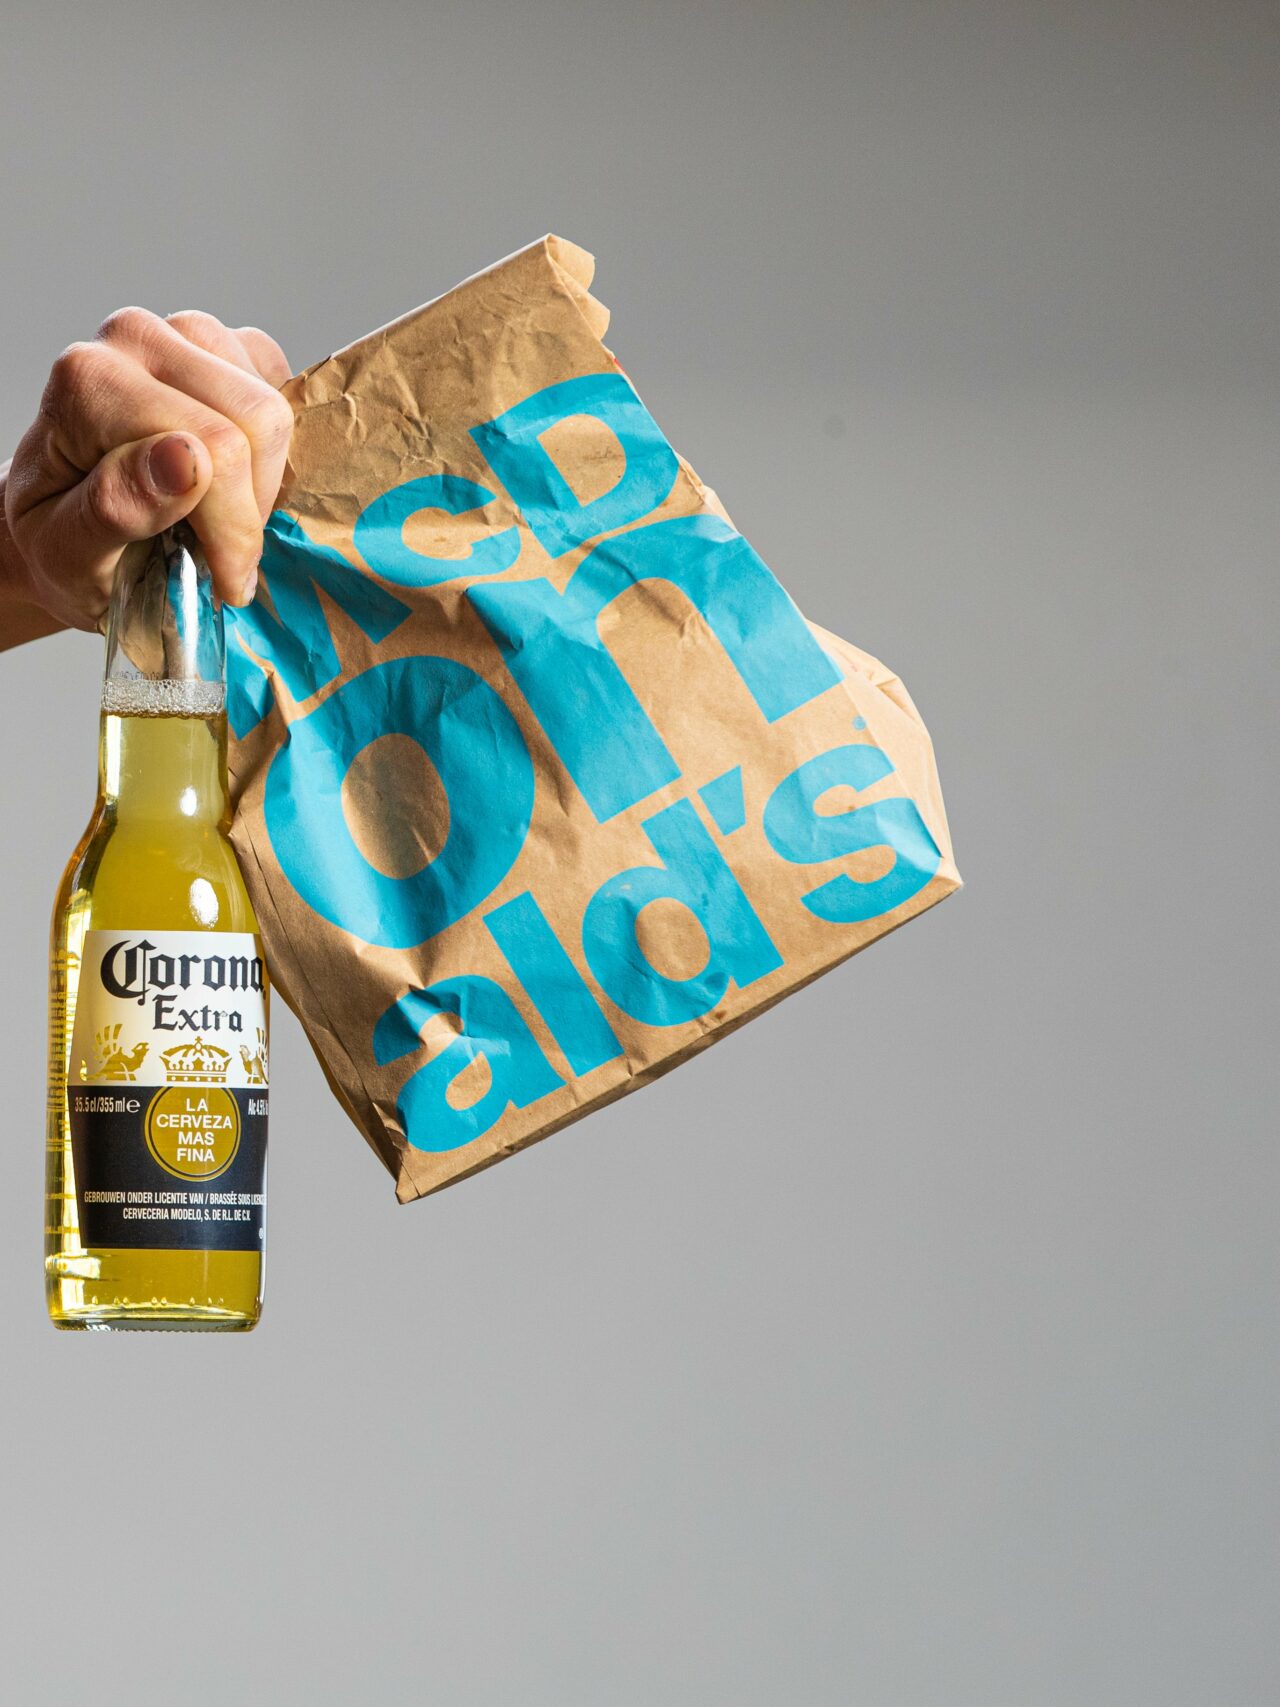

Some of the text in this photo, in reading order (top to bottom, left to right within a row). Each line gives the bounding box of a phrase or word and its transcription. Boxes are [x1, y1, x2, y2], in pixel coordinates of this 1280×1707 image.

[264, 514, 845, 949] on
[100, 939, 265, 1006] Corona
[152, 994, 243, 1033] Extra
[185, 1098, 209, 1112] LA
[156, 1114, 233, 1130] CERVEZA
[178, 1132, 215, 1147] MAS
[176, 1148, 215, 1162] FINA
[84, 1191, 126, 1203] GEBROUWEN
[127, 1191, 153, 1204] ONDER
[155, 1192, 187, 1205] LICENTIE
[189, 1192, 204, 1205] VAN
[209, 1190, 237, 1205] BRASSÉE
[238, 1193, 251, 1206] SOUS
[123, 1207, 169, 1220] CERVECERIA
[170, 1208, 203, 1222] MODELO,
[204, 1208, 211, 1221] S.
[212, 1209, 221, 1221] DE
